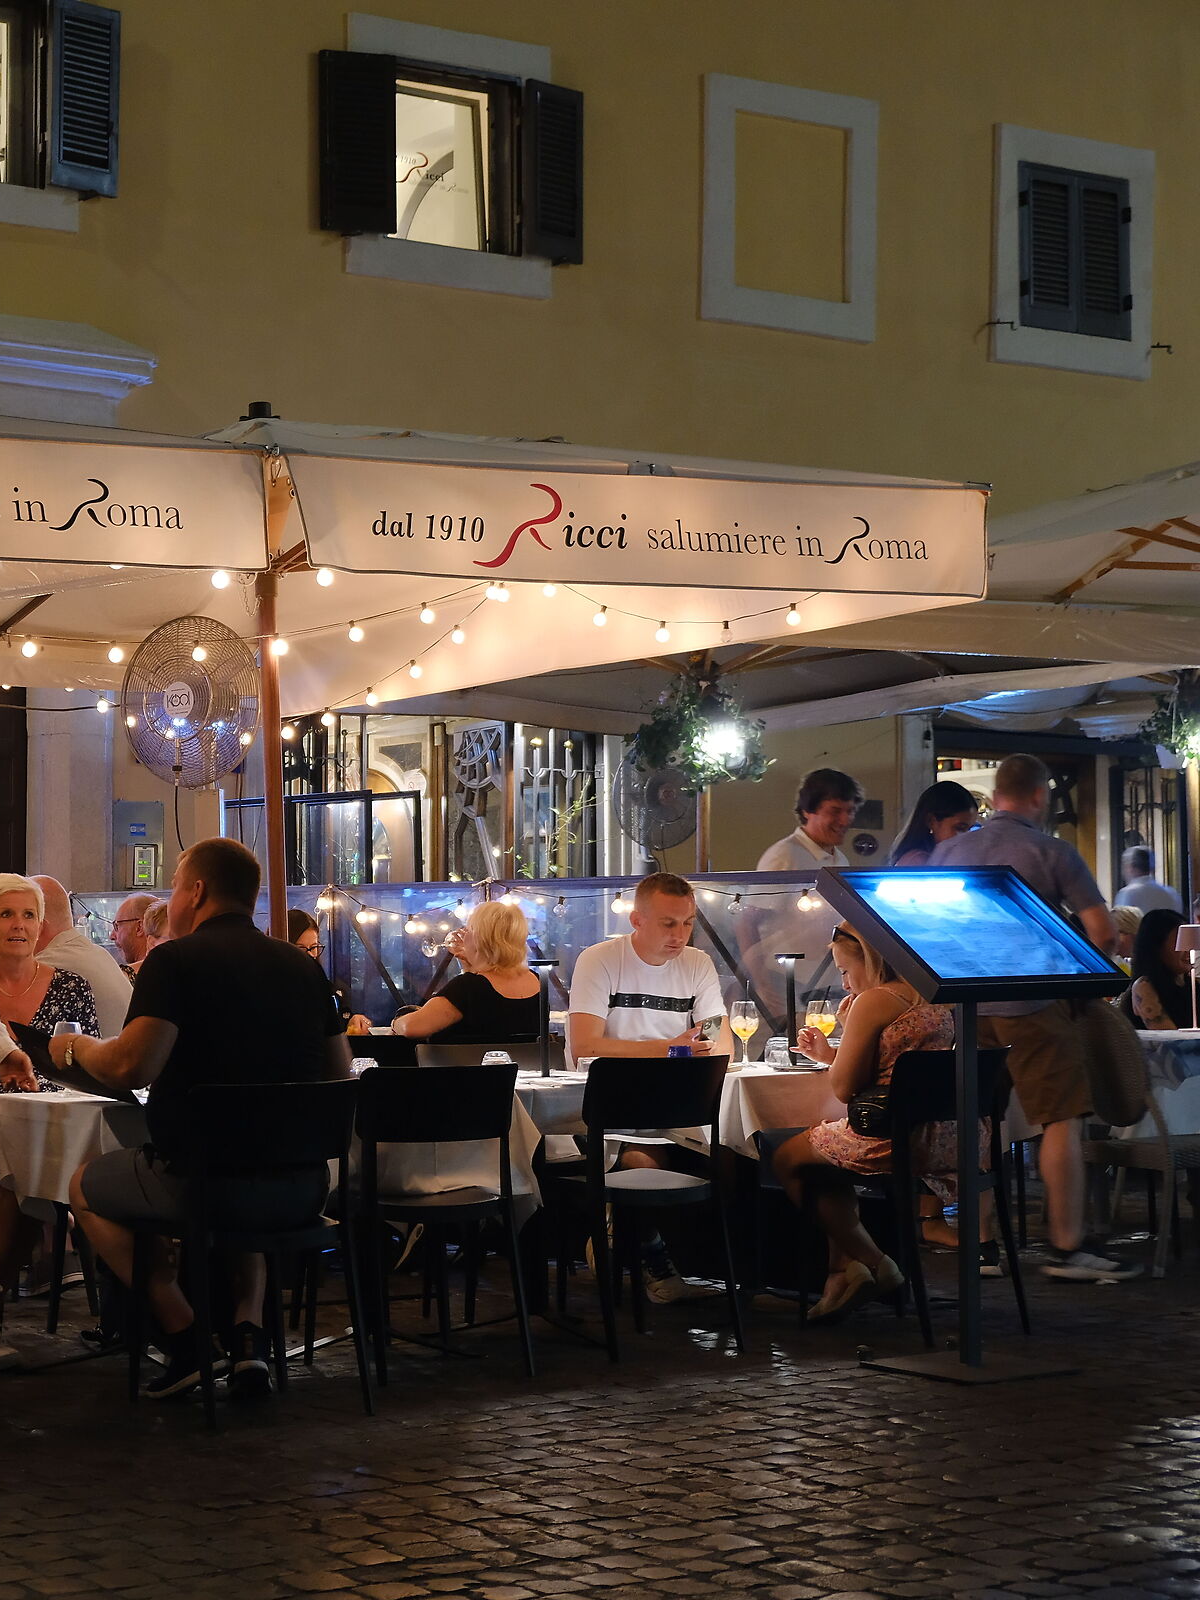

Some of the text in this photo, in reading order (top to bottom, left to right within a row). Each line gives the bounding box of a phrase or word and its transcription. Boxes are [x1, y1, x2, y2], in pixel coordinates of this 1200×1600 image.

[11, 486, 49, 523] in
[48, 478, 184, 531] Roma
[371, 483, 929, 568] dal 1910 Ricci salumiere in Roma
